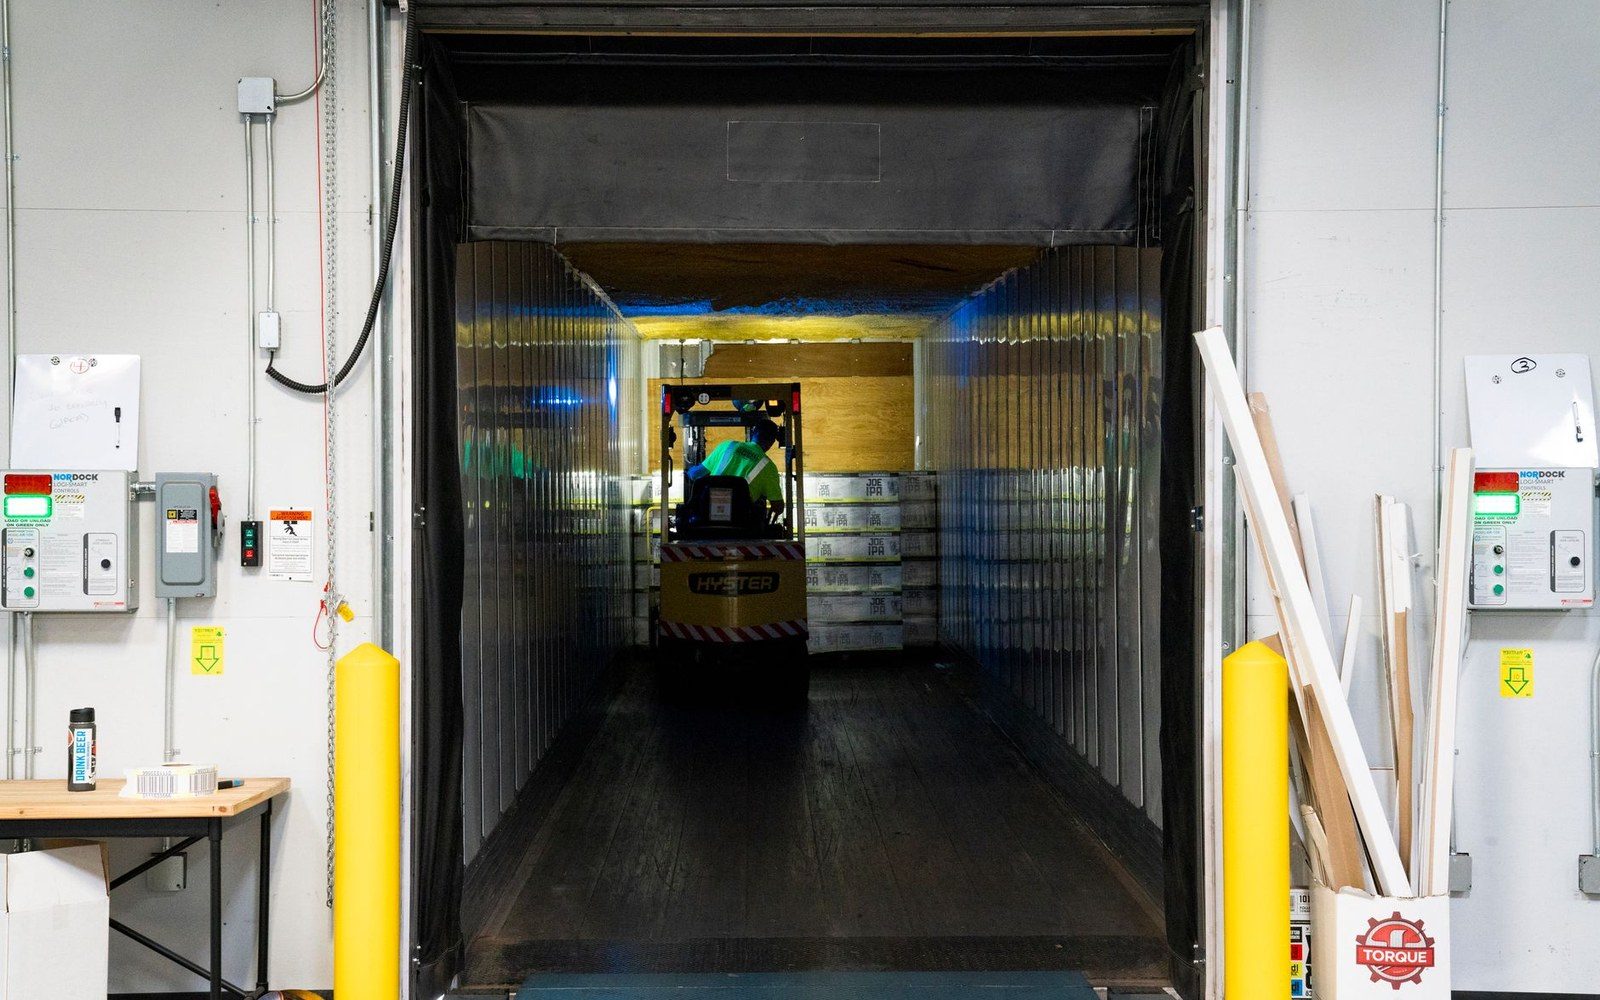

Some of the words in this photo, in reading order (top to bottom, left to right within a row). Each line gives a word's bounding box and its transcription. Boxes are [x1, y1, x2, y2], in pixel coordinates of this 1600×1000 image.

[1519, 360, 1530, 372] 3
[53, 473, 99, 481] NORDOCK
[1520, 471, 1565, 479] NORDOCK
[866, 478, 883, 487] JOE
[866, 487, 883, 497] IPA
[868, 537, 885, 546] JOE
[868, 546, 885, 556] IPA
[697, 576, 773, 590] HYSTER
[870, 597, 885, 606] JOE
[870, 606, 886, 615] IPA
[76, 731, 86, 753] BEER
[75, 755, 86, 781] DRINK
[1363, 949, 1427, 963] TORQUE
